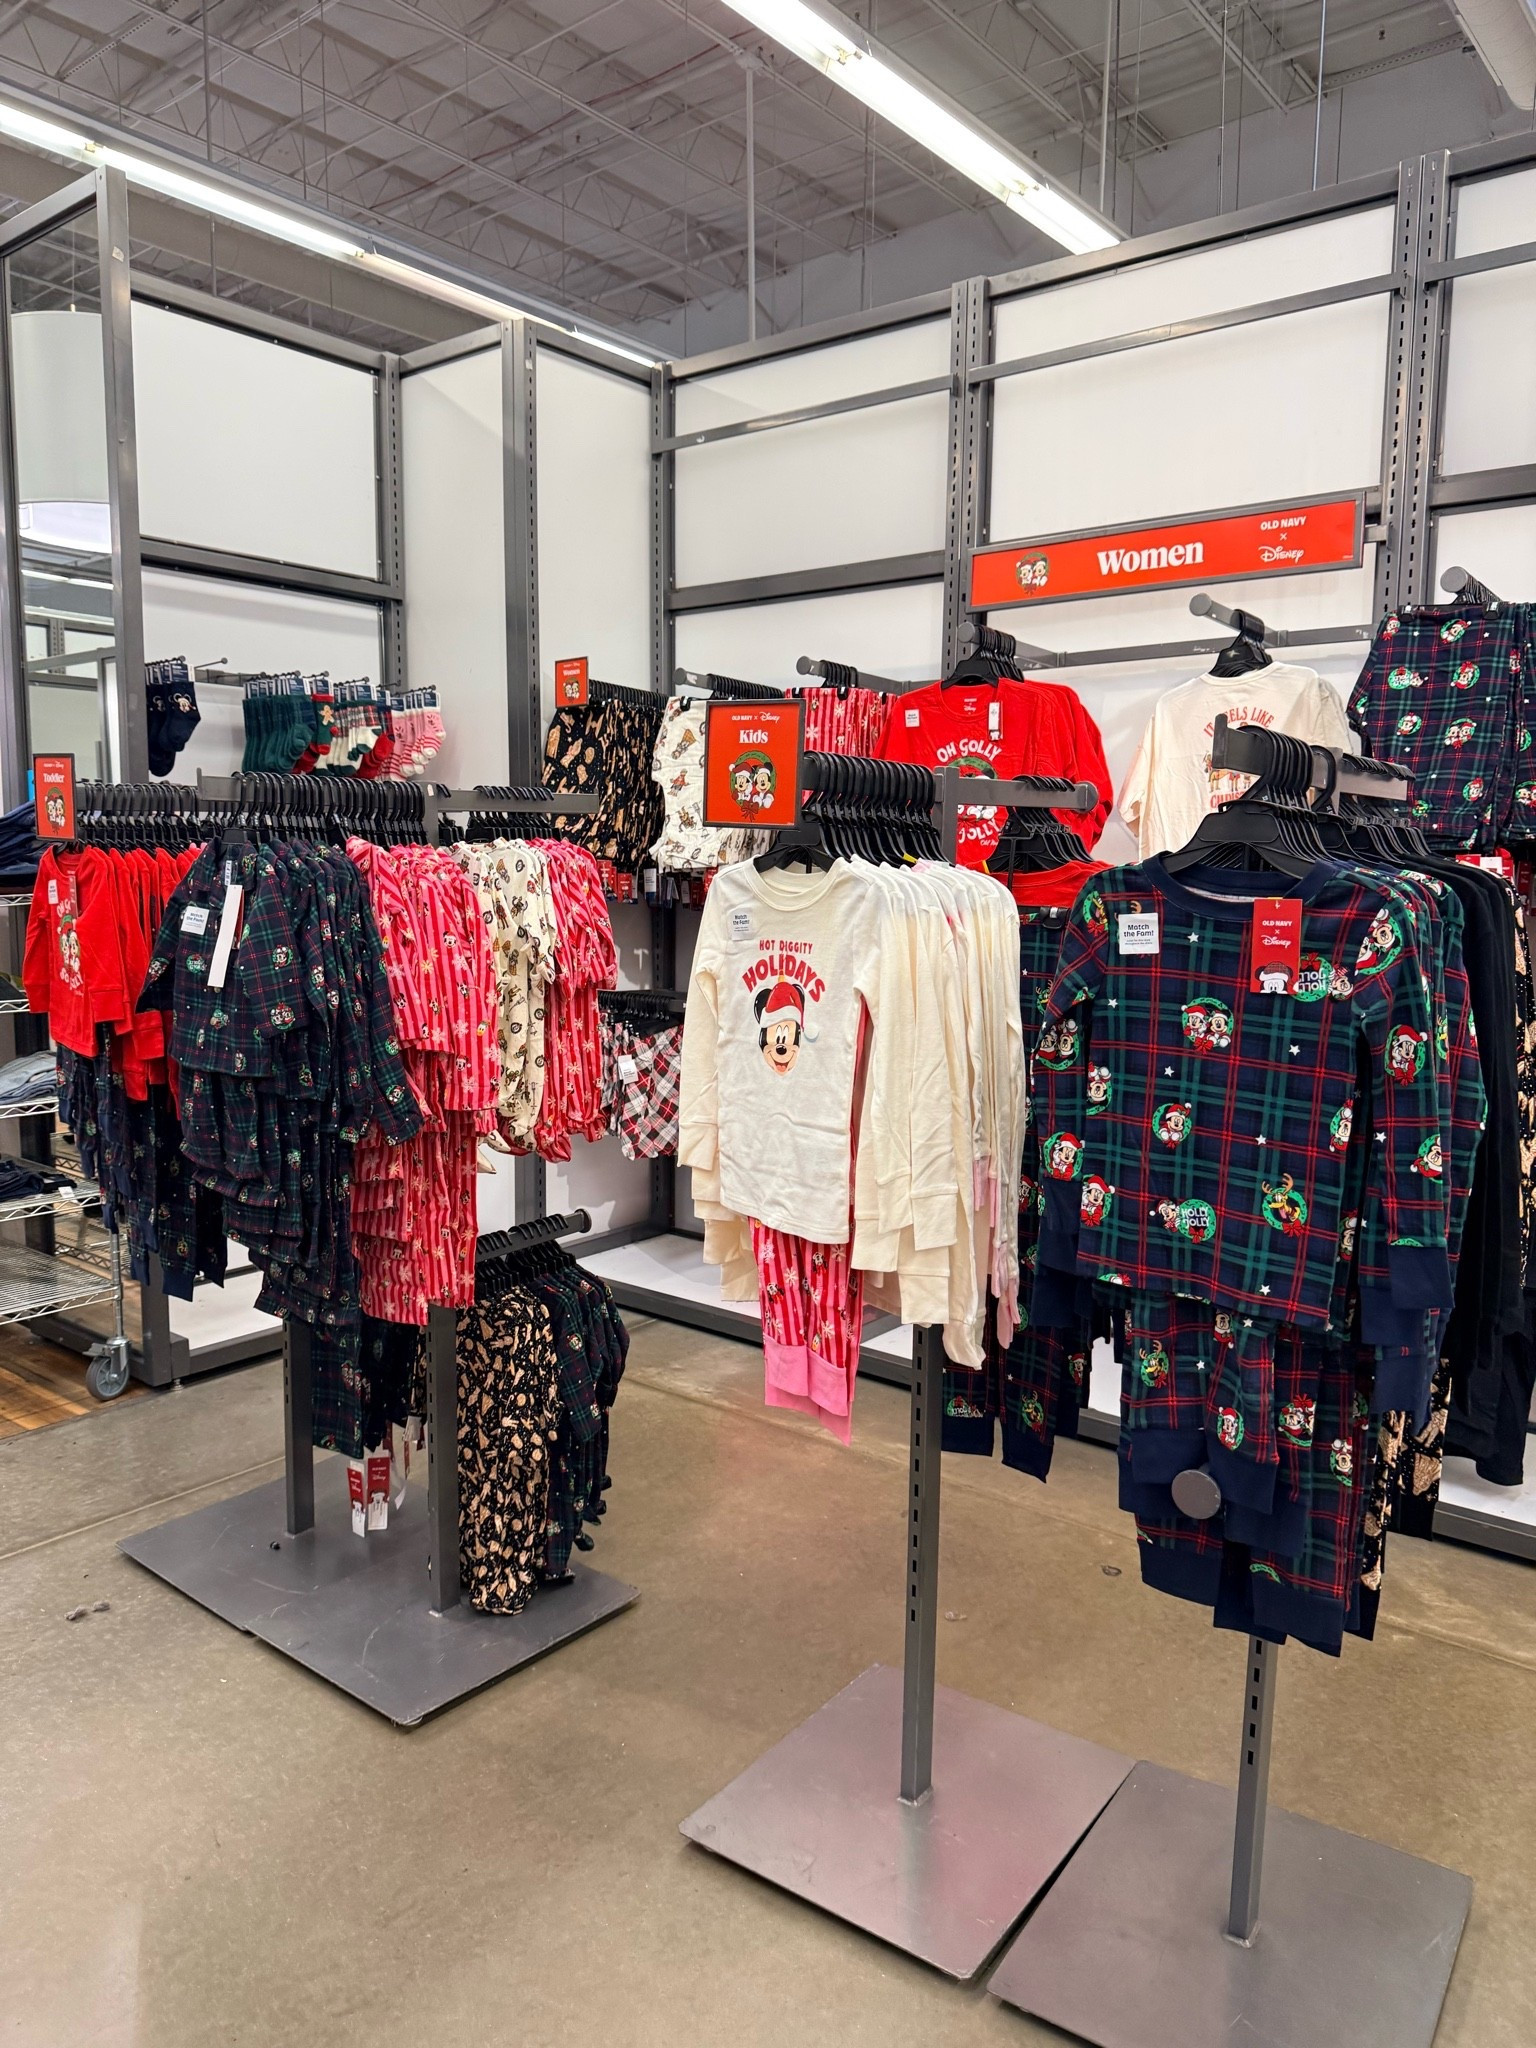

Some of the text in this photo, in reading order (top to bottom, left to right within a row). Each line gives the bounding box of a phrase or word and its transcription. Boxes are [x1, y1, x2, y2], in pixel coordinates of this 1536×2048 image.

[1260, 516, 1307, 531] OLD NAVY
[1097, 541, 1204, 576] Women
[1258, 546, 1305, 564] Disney
[1250, 706, 1275, 729] LIKE
[738, 729, 769, 744] Kids
[936, 738, 1002, 763] OH GOLLY
[43, 772, 65, 783] Toddler
[958, 817, 1001, 844] JOLLY
[1127, 923, 1150, 931] Match
[759, 940, 813, 954] HOT DIGGITY
[1260, 934, 1292, 949] Disney
[742, 953, 826, 1003] HOLIDAYS
[1182, 1206, 1209, 1218] HOLLY
[1182, 1216, 1210, 1229] JOLLY
